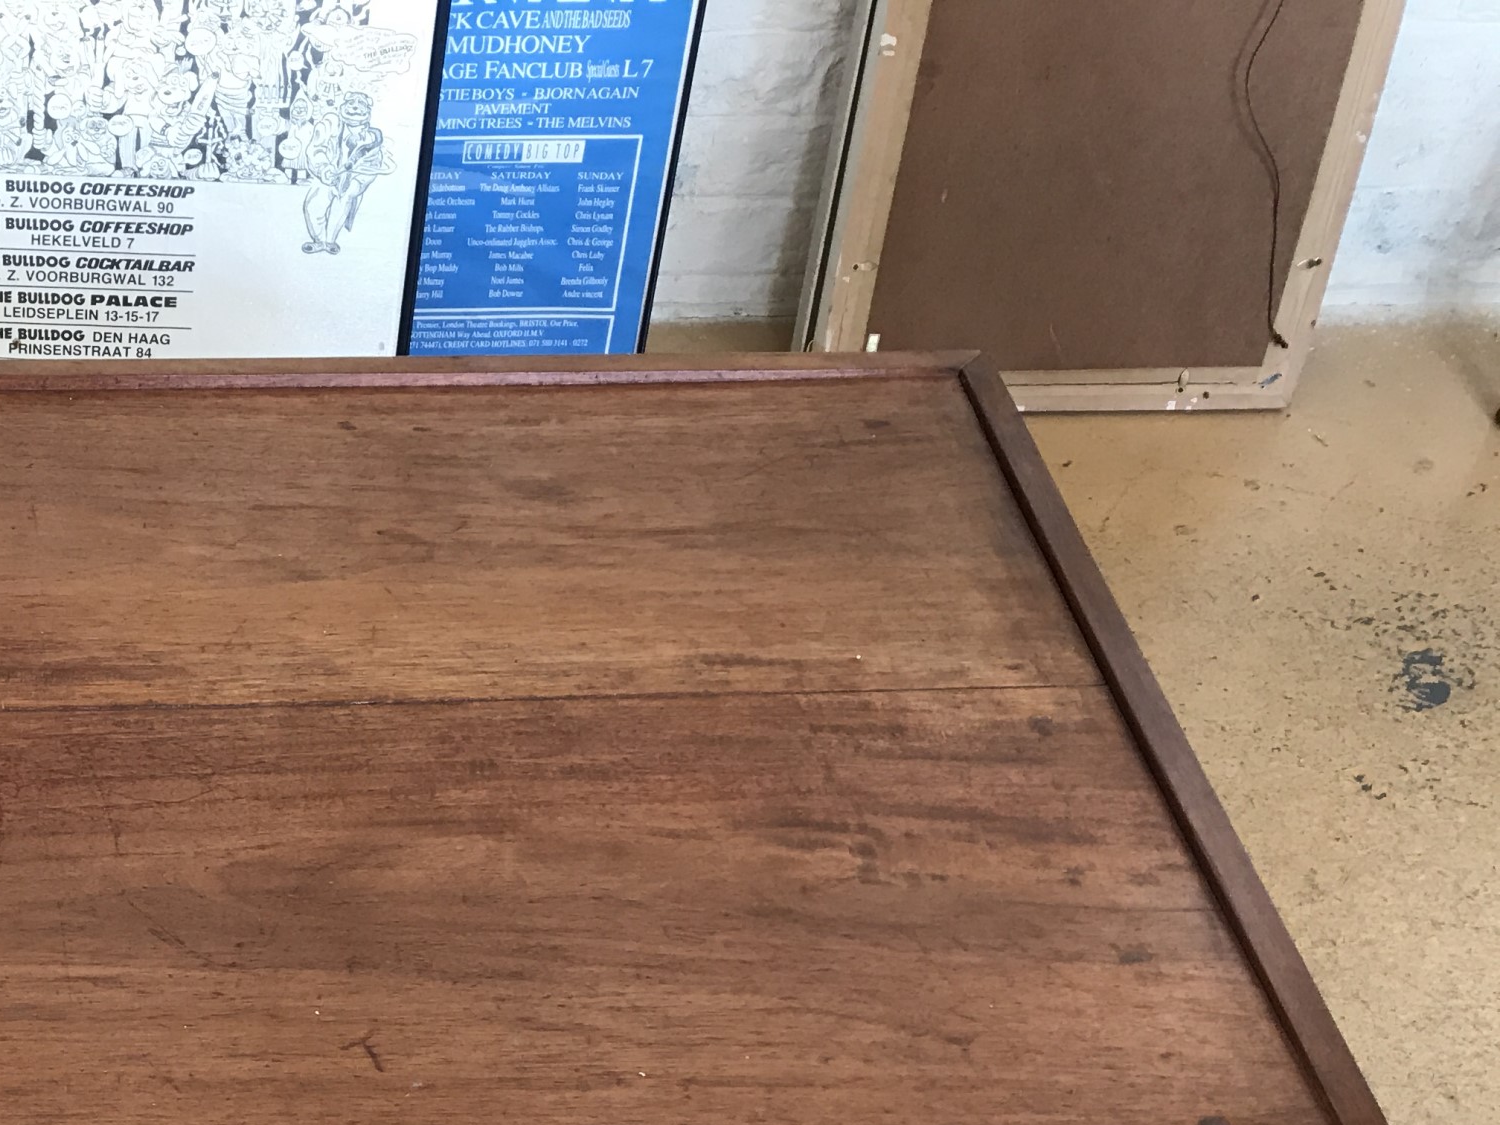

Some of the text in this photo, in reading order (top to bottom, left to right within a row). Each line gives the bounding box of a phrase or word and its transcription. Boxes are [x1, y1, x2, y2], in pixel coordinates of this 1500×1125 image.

[475, 10, 540, 30] CAVE
[447, 35, 591, 54] MUDHONEY
[484, 60, 583, 80] FANCLUB
[622, 59, 638, 78] L
[640, 59, 654, 78] 7
[533, 87, 586, 100] BJORN
[585, 86, 640, 100] AGAIN
[474, 103, 552, 116] PAVEMENT
[478, 116, 522, 129] TREES
[536, 116, 565, 129] THE
[567, 116, 632, 129] MELVINS
[467, 143, 580, 160] COMEDY BIG TOP
[490, 171, 551, 180] SATURDAY
[577, 171, 624, 181] SUNDAY
[5, 179, 75, 195] BULLDOG
[80, 182, 195, 199] COFFEESHOP
[10, 197, 23, 208] Z.
[29, 197, 152, 213] VOORBURGWAL
[157, 202, 175, 214] 90
[5, 217, 75, 232] BULLDOG
[79, 220, 194, 236] COFFEESHOP
[31, 234, 135, 249] HEKELVELD 7
[2, 254, 71, 269] BULLDOG
[75, 257, 196, 272] COCKTAILBAR
[7, 270, 20, 281] Z.
[26, 270, 146, 286] VOORBURGWAL
[152, 275, 175, 287] 132
[17, 291, 85, 306] BULLDOG
[90, 294, 177, 308] PALACE
[3, 306, 160, 322] LEIDSEPLEIN 13-15-17
[18, 327, 85, 342] BULLDOG
[92, 331, 123, 344] DEN
[128, 332, 171, 345] HAAG
[8, 342, 152, 358] PRINSENSTRAAT 84
